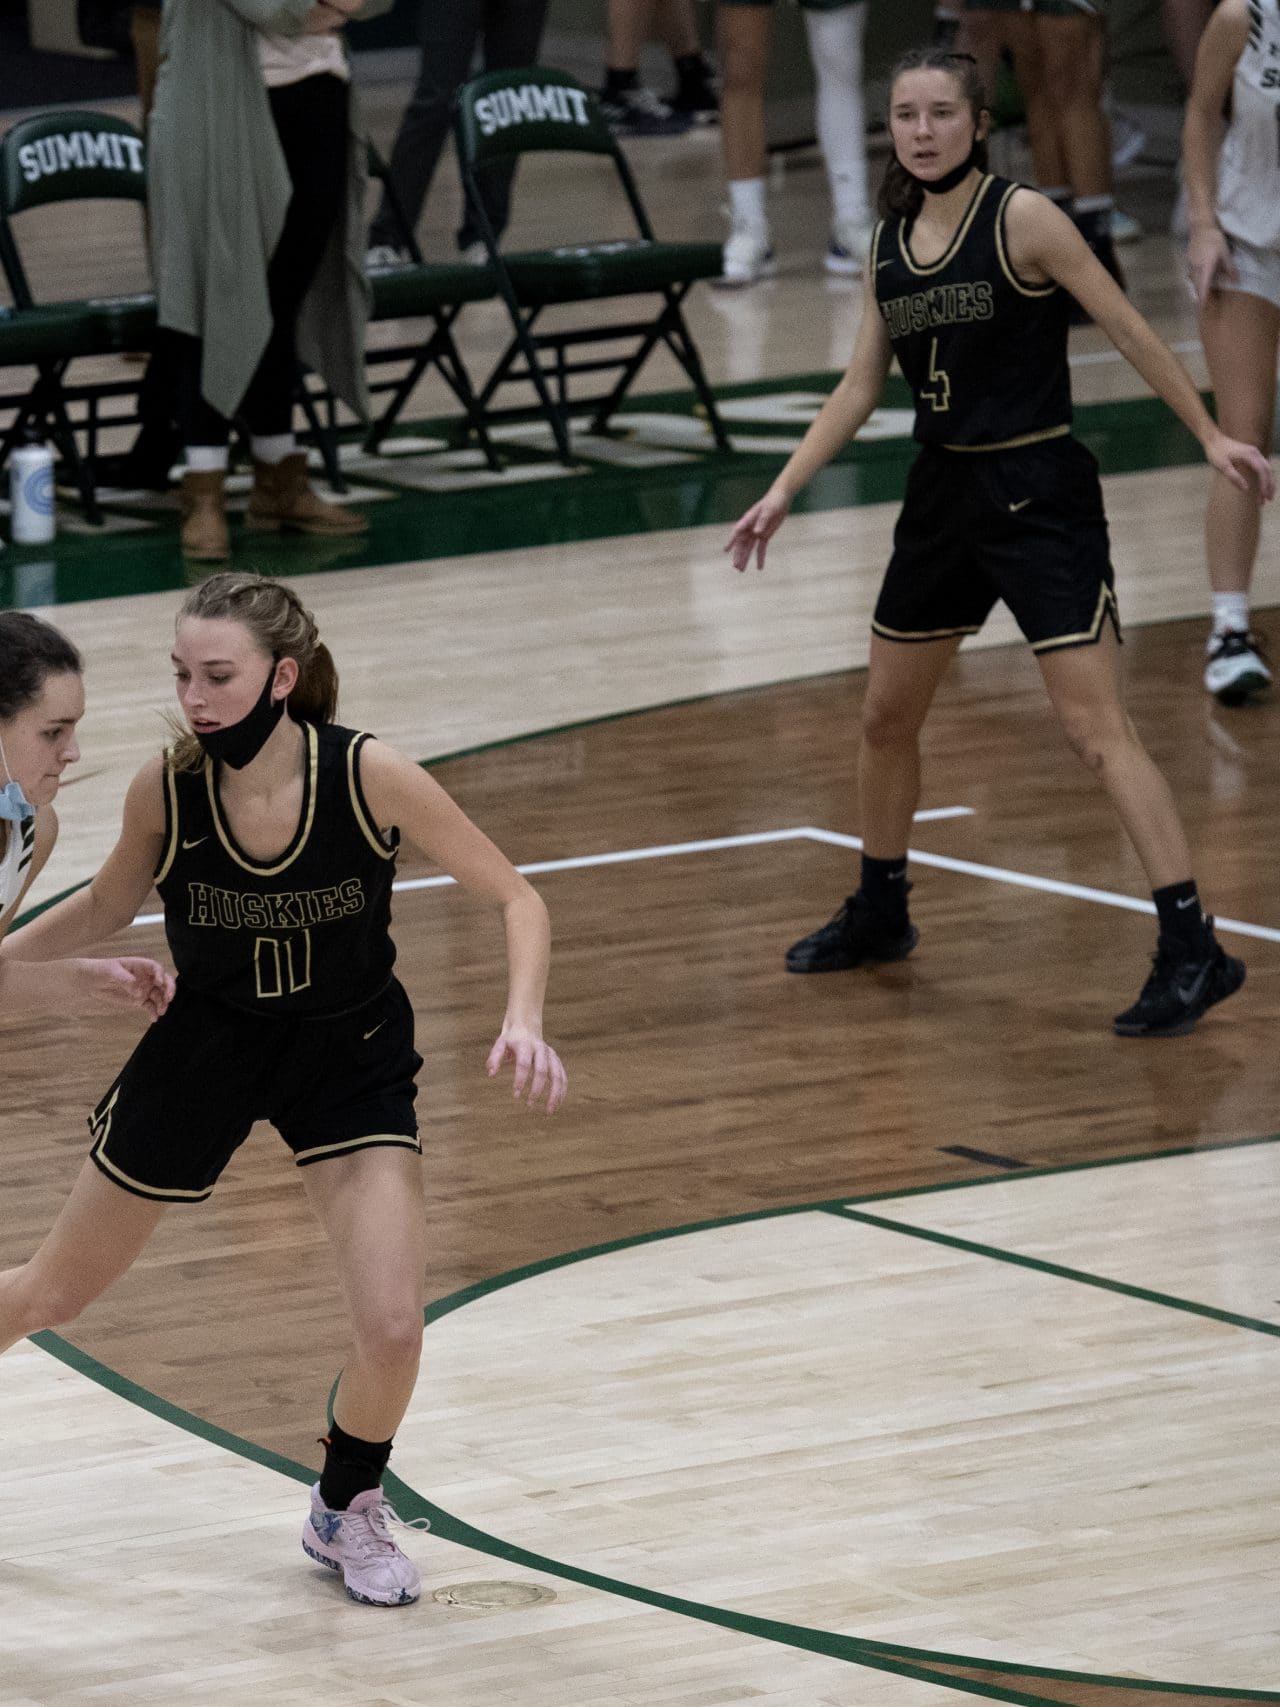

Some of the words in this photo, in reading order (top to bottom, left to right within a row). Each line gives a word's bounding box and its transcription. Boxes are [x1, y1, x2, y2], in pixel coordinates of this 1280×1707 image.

[474, 84, 590, 136] SUMMIT
[19, 131, 144, 183] SUMMIT
[880, 281, 995, 339] HUSKIES
[920, 336, 951, 412] 4
[188, 878, 365, 929] HUSKIES
[254, 928, 312, 998] 11
